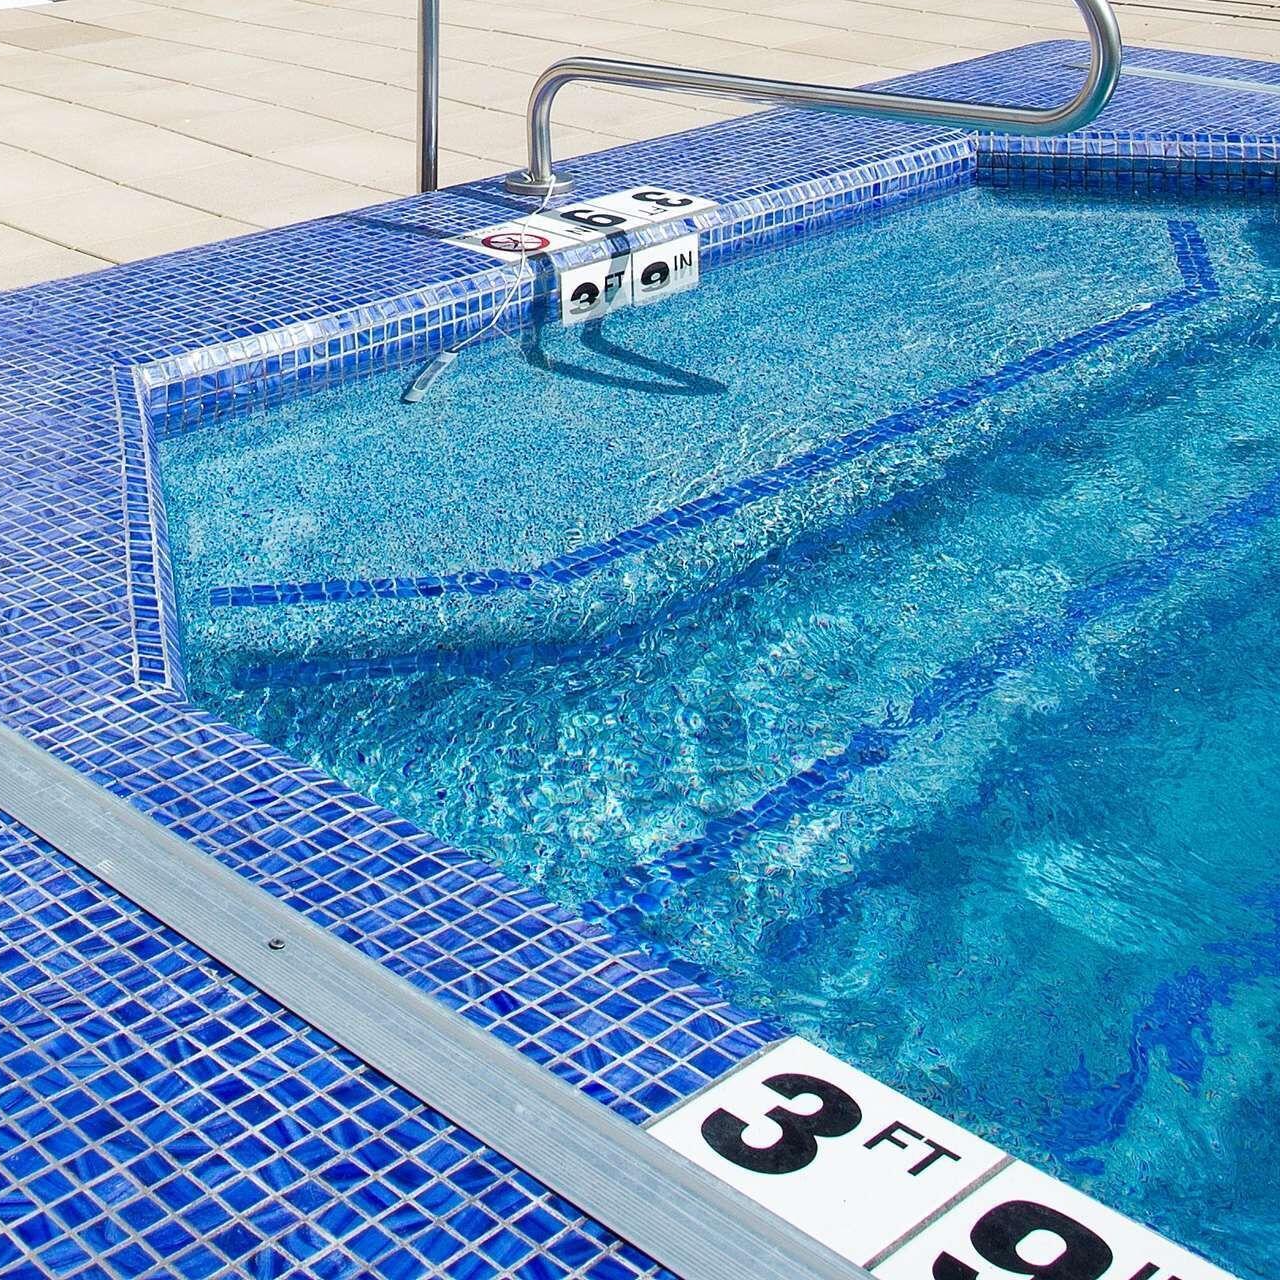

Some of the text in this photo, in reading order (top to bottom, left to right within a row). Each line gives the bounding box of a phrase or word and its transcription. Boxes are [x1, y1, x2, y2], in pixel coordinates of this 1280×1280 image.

[632, 192, 693, 207] 3
[638, 205, 668, 216] FT
[566, 225, 599, 235] IN
[570, 251, 693, 314] 3 FT 9 IN
[701, 1072, 1113, 1280] 3 FT 9
